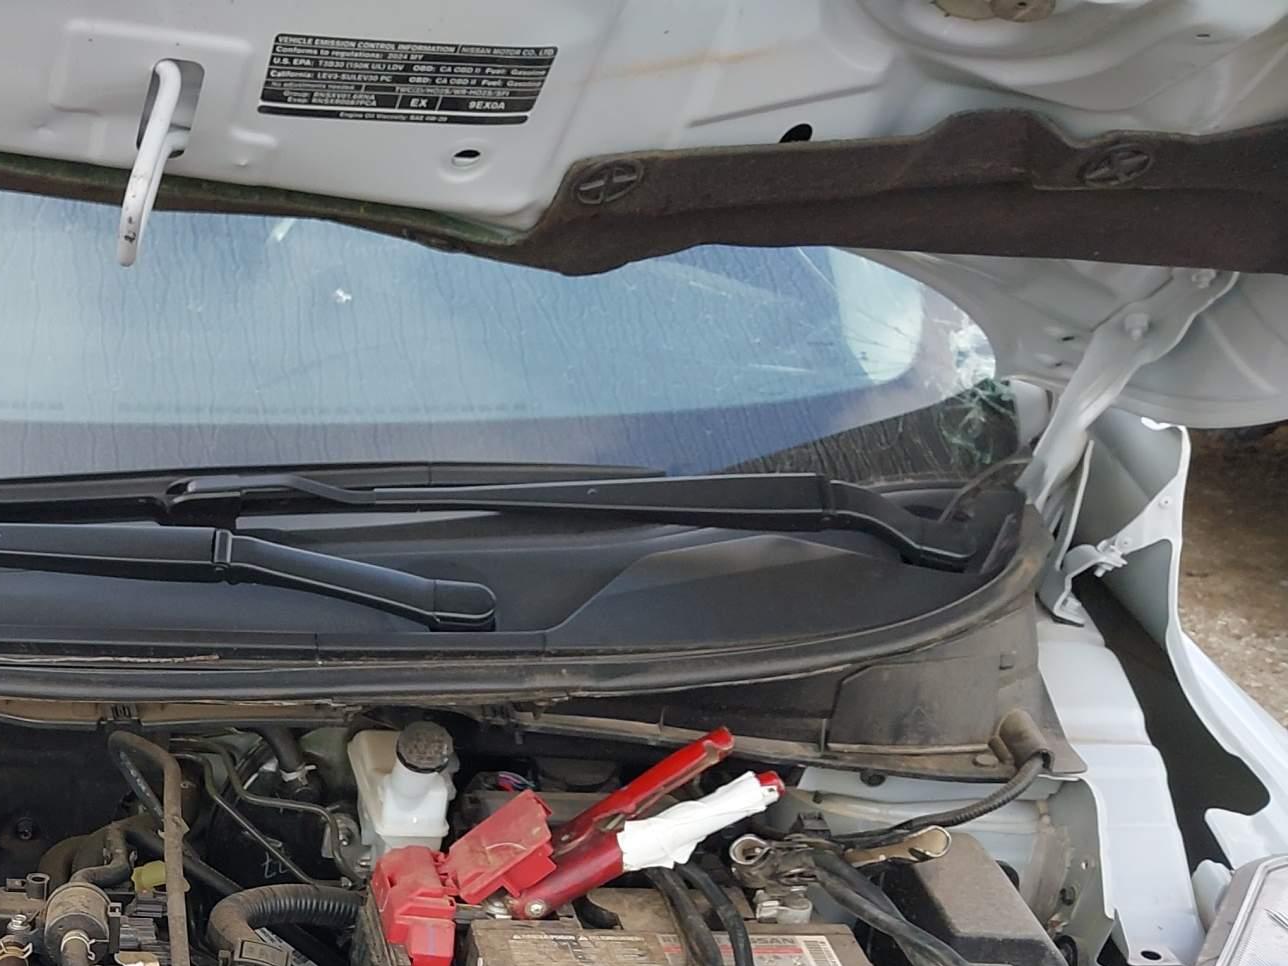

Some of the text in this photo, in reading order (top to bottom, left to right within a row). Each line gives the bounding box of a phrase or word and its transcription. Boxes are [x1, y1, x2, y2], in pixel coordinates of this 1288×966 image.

[277, 35, 456, 53] VEHICLE EMISSION CONTROL INFORMATION
[461, 46, 491, 55] NISSAN
[492, 47, 521, 56] MOTOR
[275, 45, 318, 55] Conforms
[319, 48, 330, 56] to
[331, 50, 384, 60] regulations:
[272, 56, 291, 66] U.S.
[292, 58, 314, 67] EPA:
[387, 63, 405, 72] LDV
[412, 64, 435, 74] OBD:
[439, 65, 452, 74] CA
[453, 66, 474, 75] OBD
[485, 67, 507, 76] Fuel:
[510, 68, 547, 77] Gasoline
[269, 69, 315, 79] California:
[380, 74, 393, 83] PC
[408, 76, 432, 85] OBD:
[435, 77, 448, 85] CA
[449, 77, 470, 86] OBD
[481, 79, 504, 87] Fuel:
[506, 80, 542, 88] Gasoline
[410, 97, 428, 108] EX
